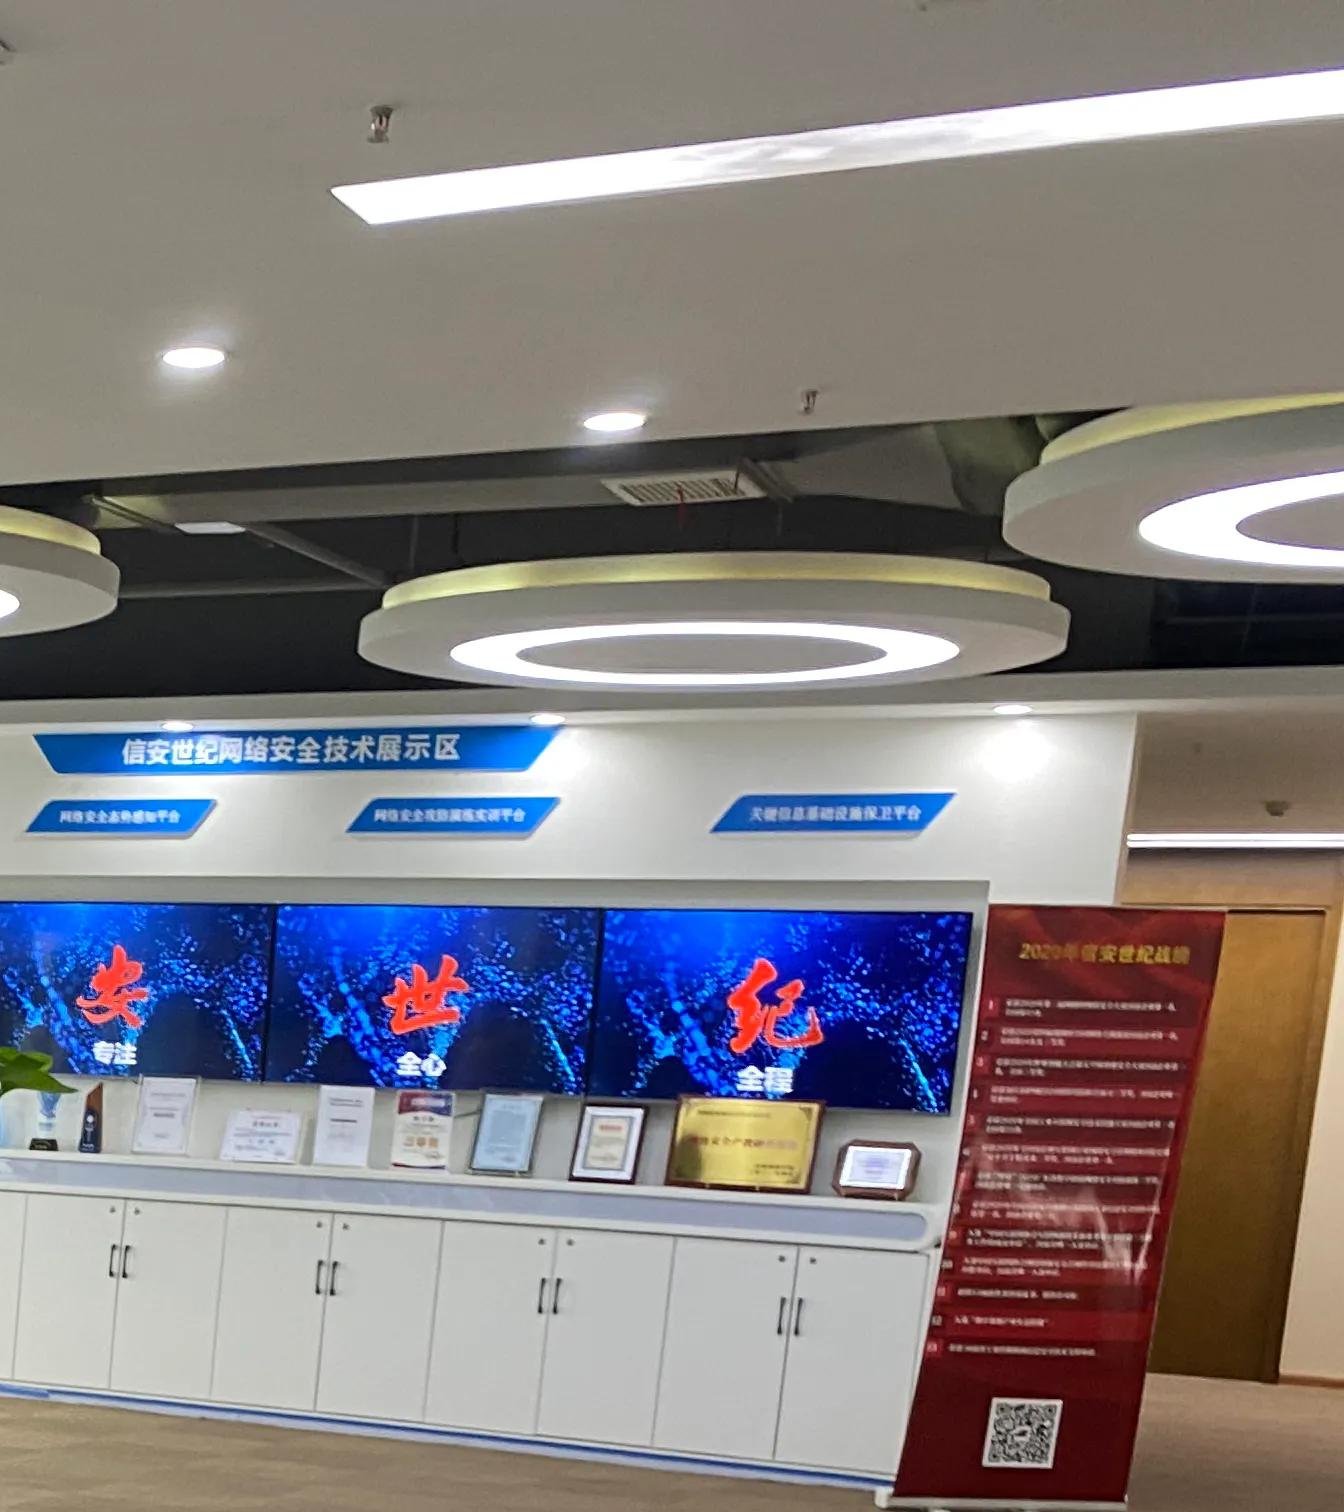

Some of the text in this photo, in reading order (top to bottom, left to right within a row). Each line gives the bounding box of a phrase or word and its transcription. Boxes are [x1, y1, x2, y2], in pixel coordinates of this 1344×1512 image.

[122, 733, 461, 765] 信安世纪网络安全技术展示区
[381, 954, 470, 1035] 世
[727, 957, 824, 1054] 纪
[395, 1051, 447, 1077] 全心
[735, 1064, 794, 1093] 全程
